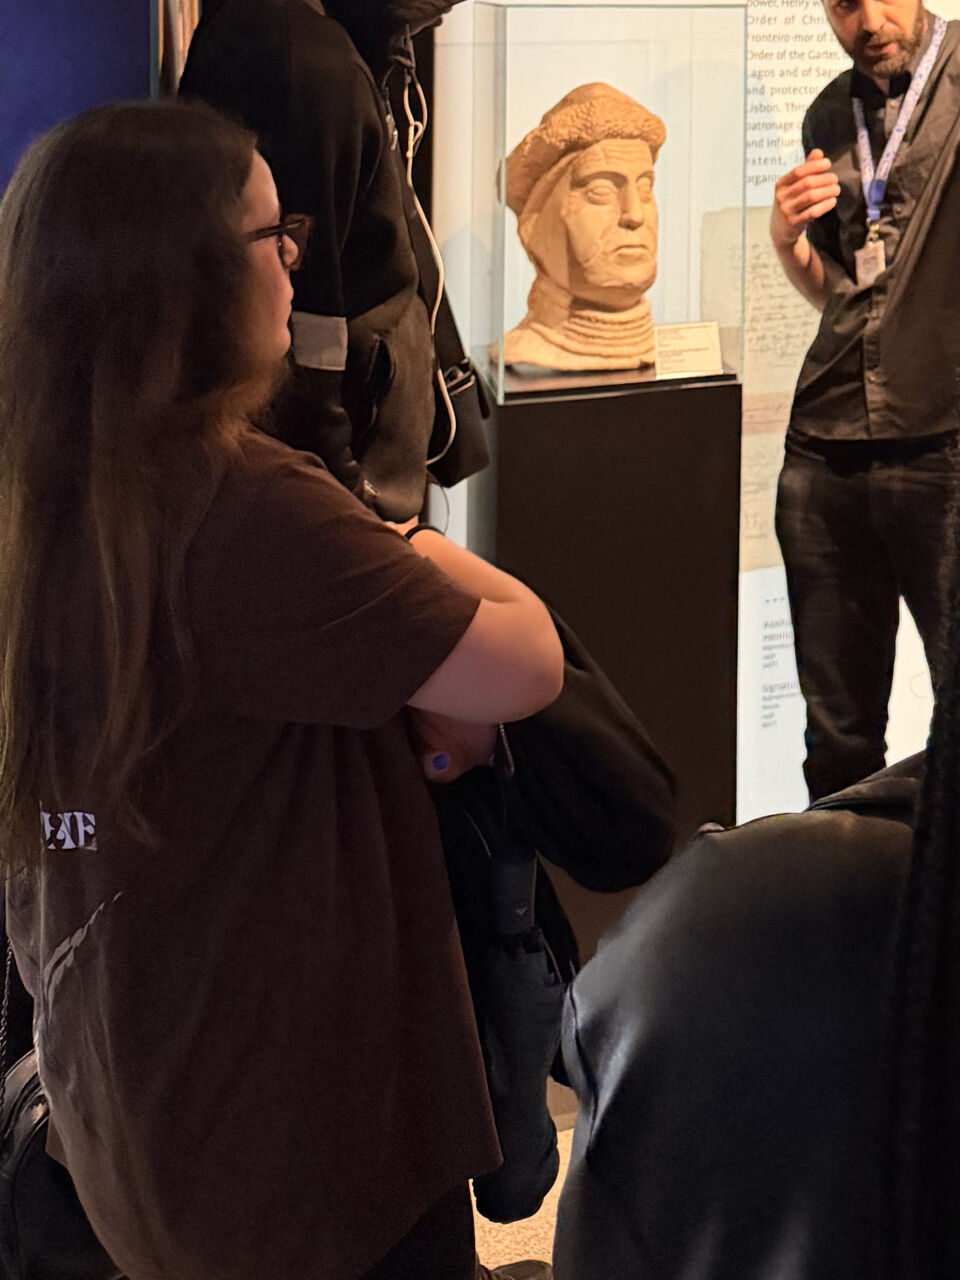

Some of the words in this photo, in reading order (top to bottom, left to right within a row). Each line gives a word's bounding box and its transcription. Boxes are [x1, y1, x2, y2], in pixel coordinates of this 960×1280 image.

[784, 14, 795, 25] of
[801, 14, 827, 25] Chri
[750, 32, 813, 43] ronteiro-mor
[816, 31, 828, 43] of
[776, 49, 786, 61] of
[788, 49, 806, 61] the
[807, 50, 842, 63] Garter,
[750, 69, 776, 81] agos
[779, 67, 799, 78] and
[801, 67, 812, 78] of
[749, 103, 782, 114] isbon.
